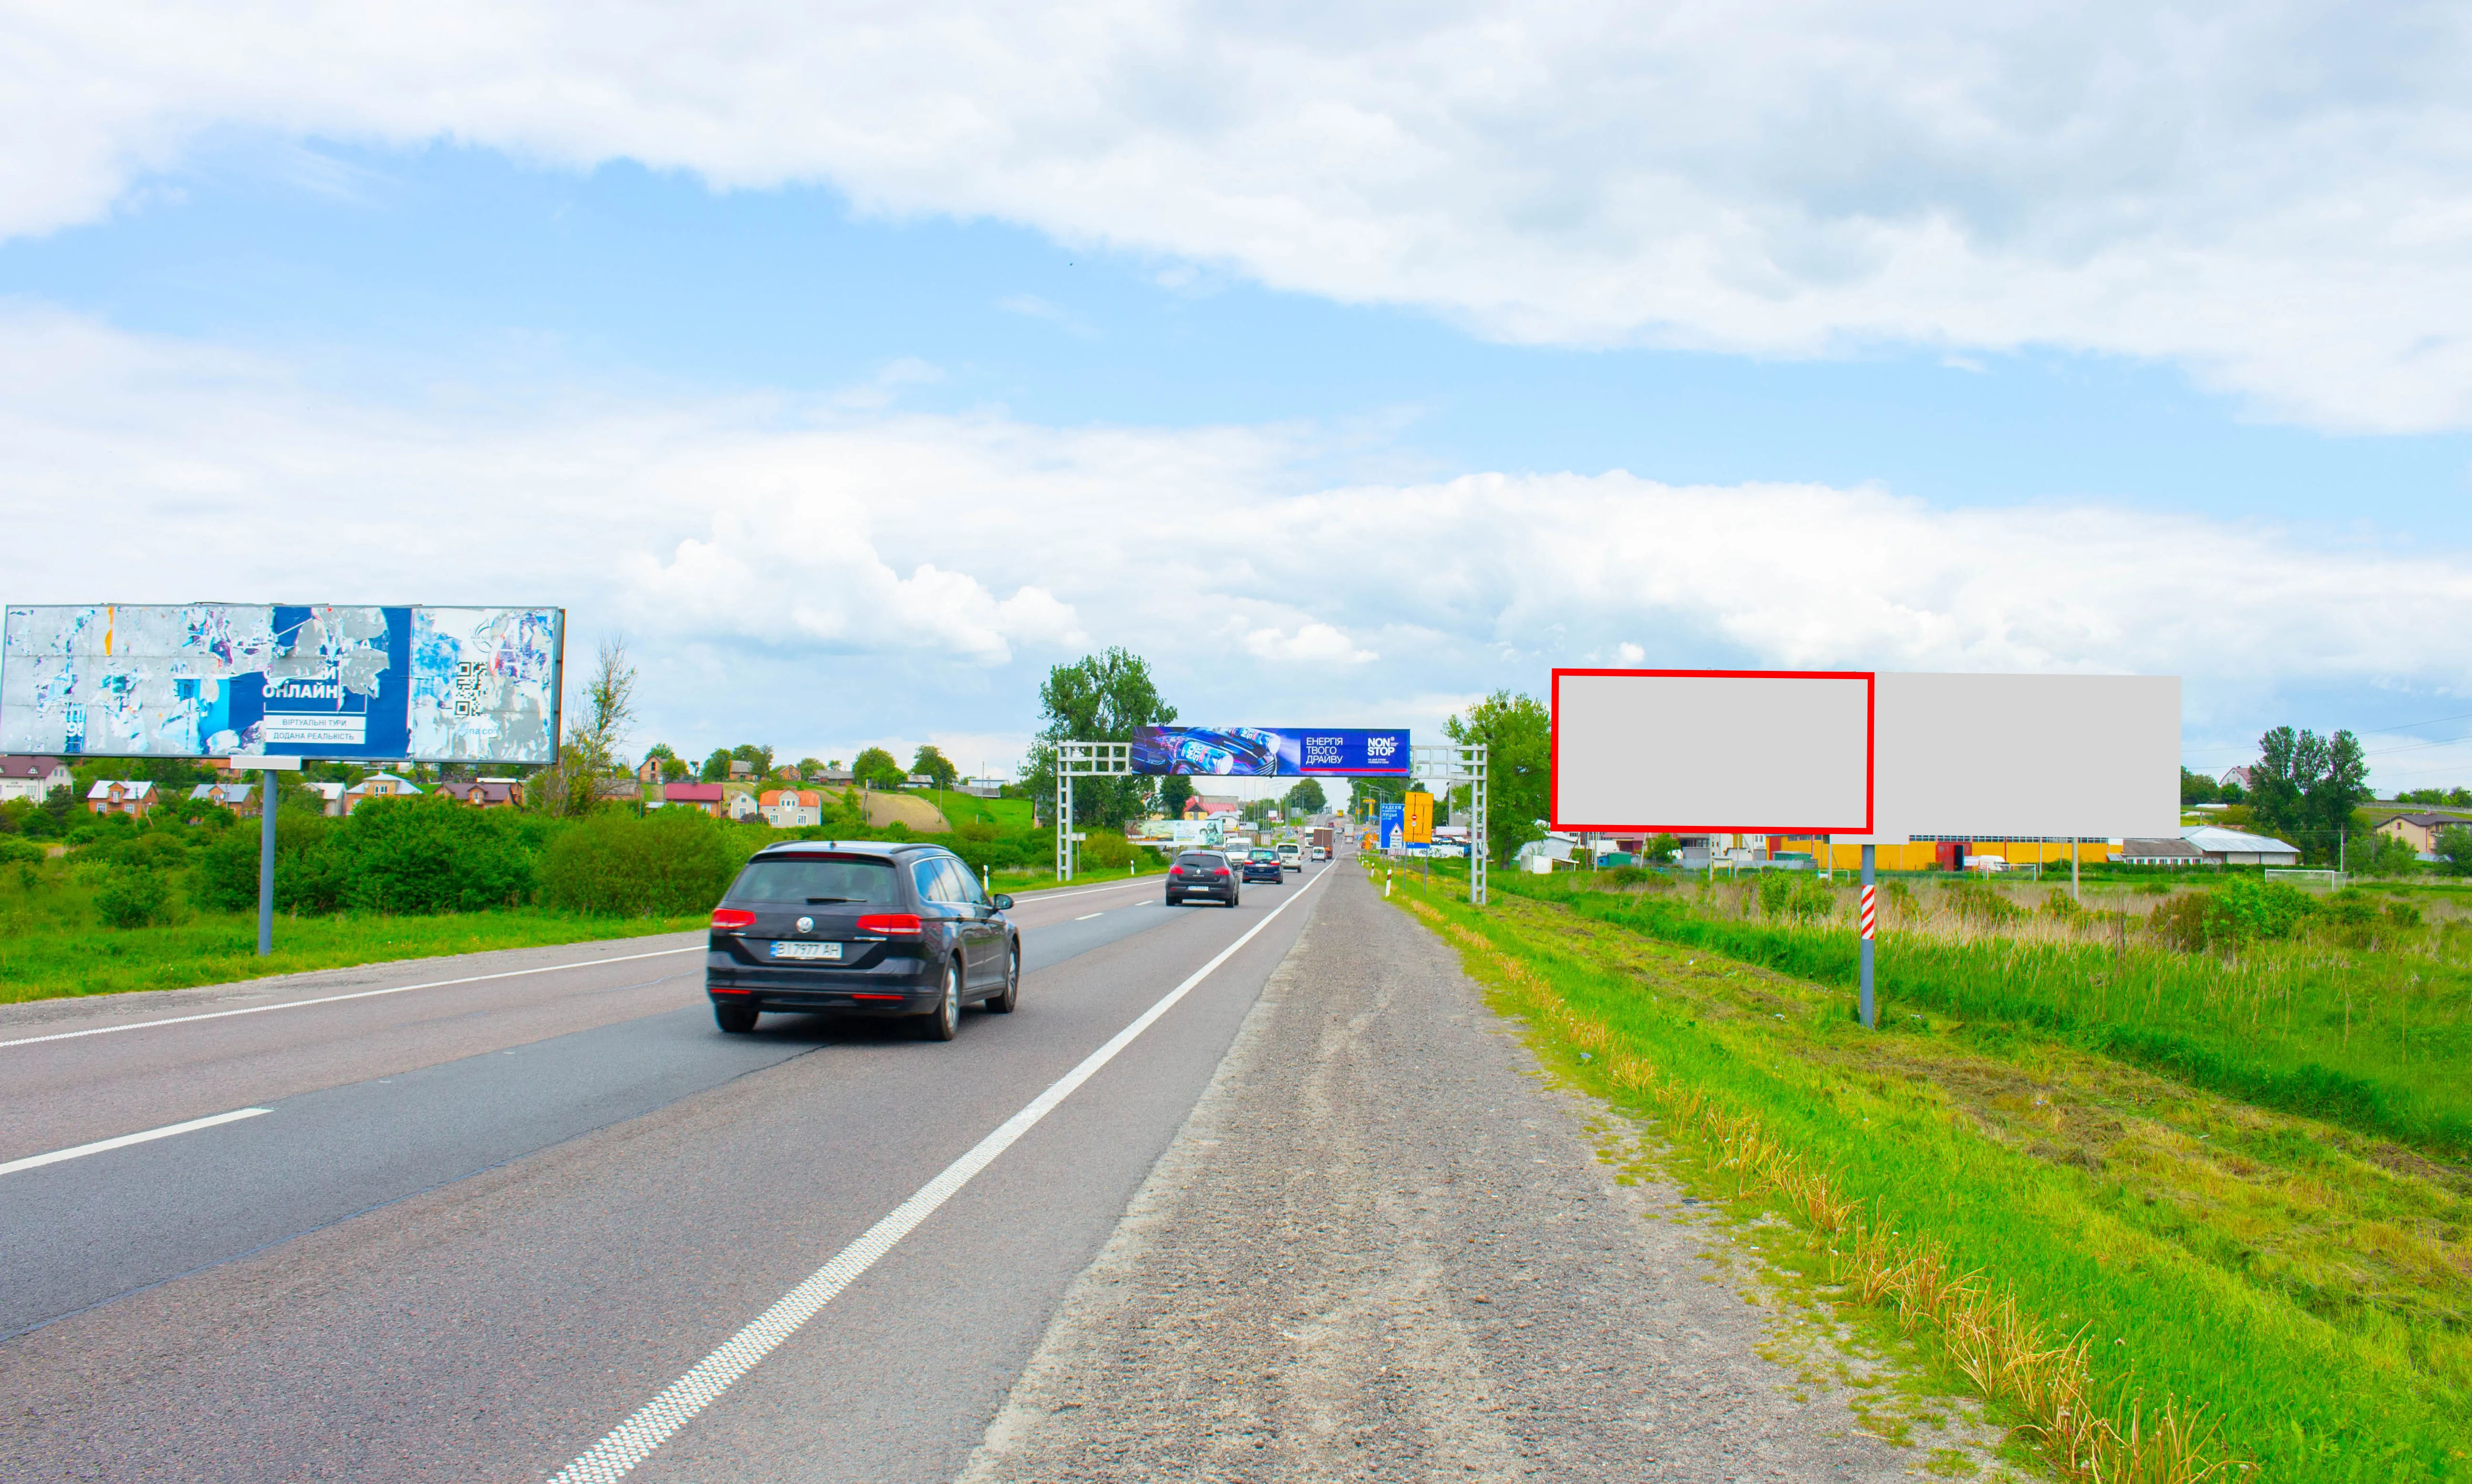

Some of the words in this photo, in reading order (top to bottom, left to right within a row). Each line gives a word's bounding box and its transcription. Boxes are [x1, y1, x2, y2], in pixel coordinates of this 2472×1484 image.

[262, 681, 338, 698] ОНЛАЙН
[1306, 737, 1343, 745] ЕНЕРГІЯ
[1368, 738, 1390, 747] NON
[1306, 746, 1337, 754] ТВОГО
[1367, 747, 1395, 756] STOP
[1306, 753, 1343, 765] ДРАЙВУ
[793, 944, 819, 955] 7977
